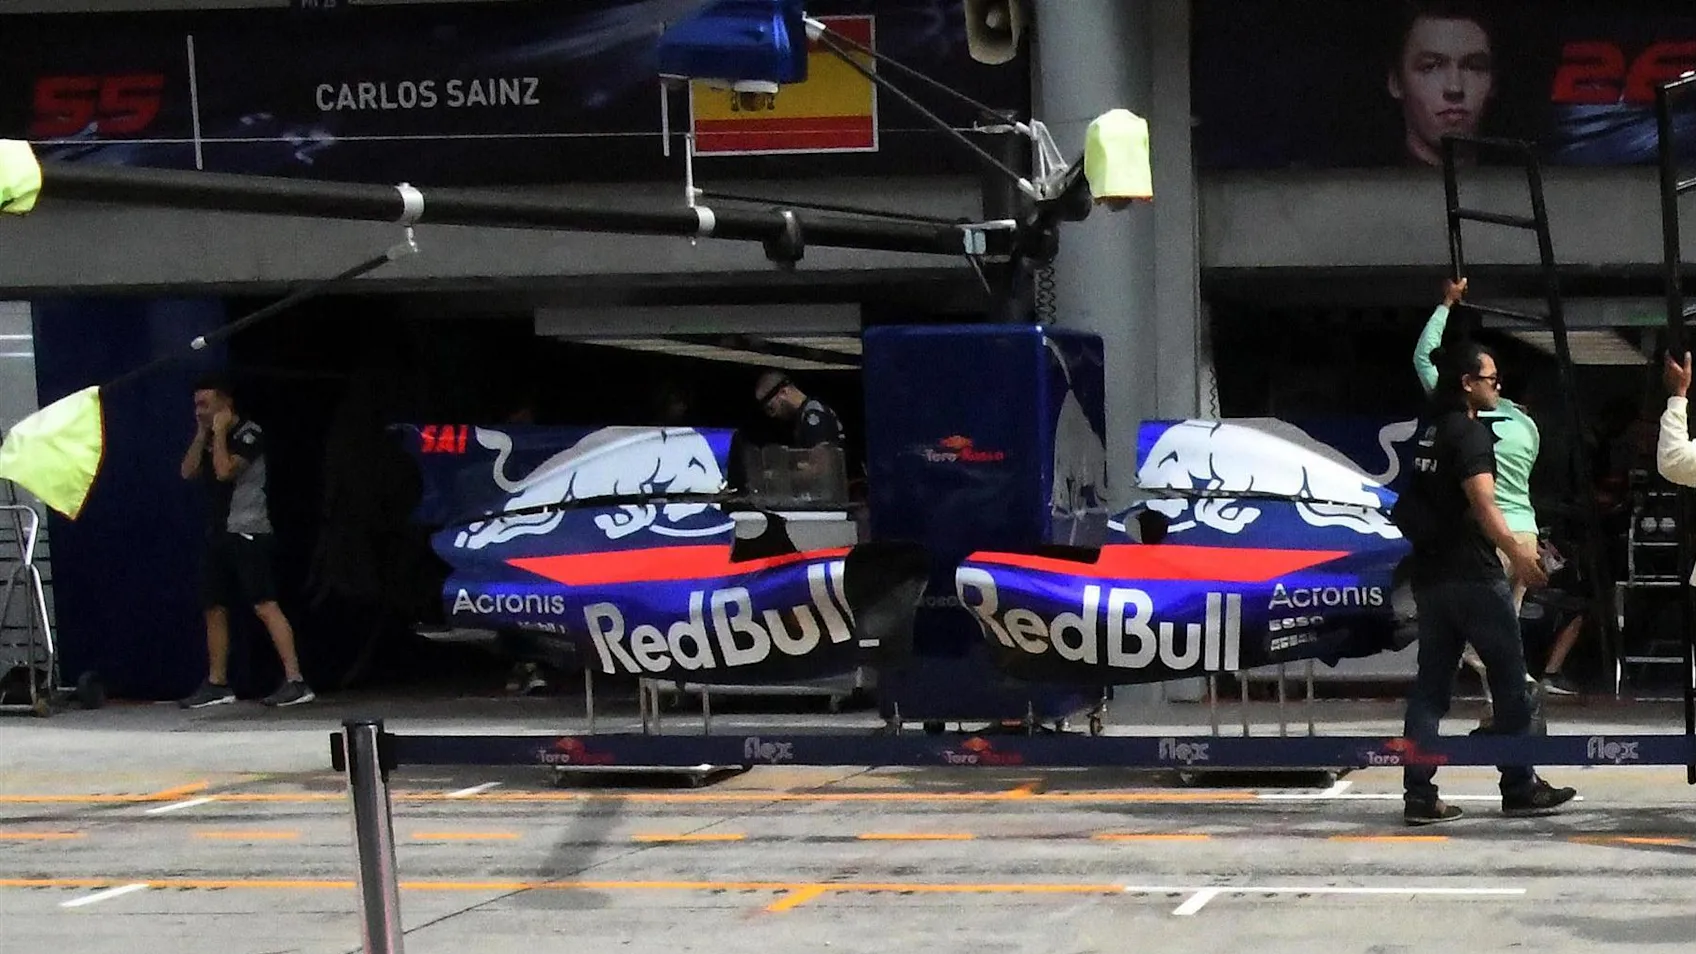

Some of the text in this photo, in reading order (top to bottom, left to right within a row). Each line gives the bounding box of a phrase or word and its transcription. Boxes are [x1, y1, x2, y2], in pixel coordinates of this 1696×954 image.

[28, 75, 164, 138] 55
[315, 76, 540, 112] CARLOS SAINZ
[421, 424, 468, 453] SAI
[453, 588, 565, 617] Acronis
[1268, 583, 1383, 610] Acronis
